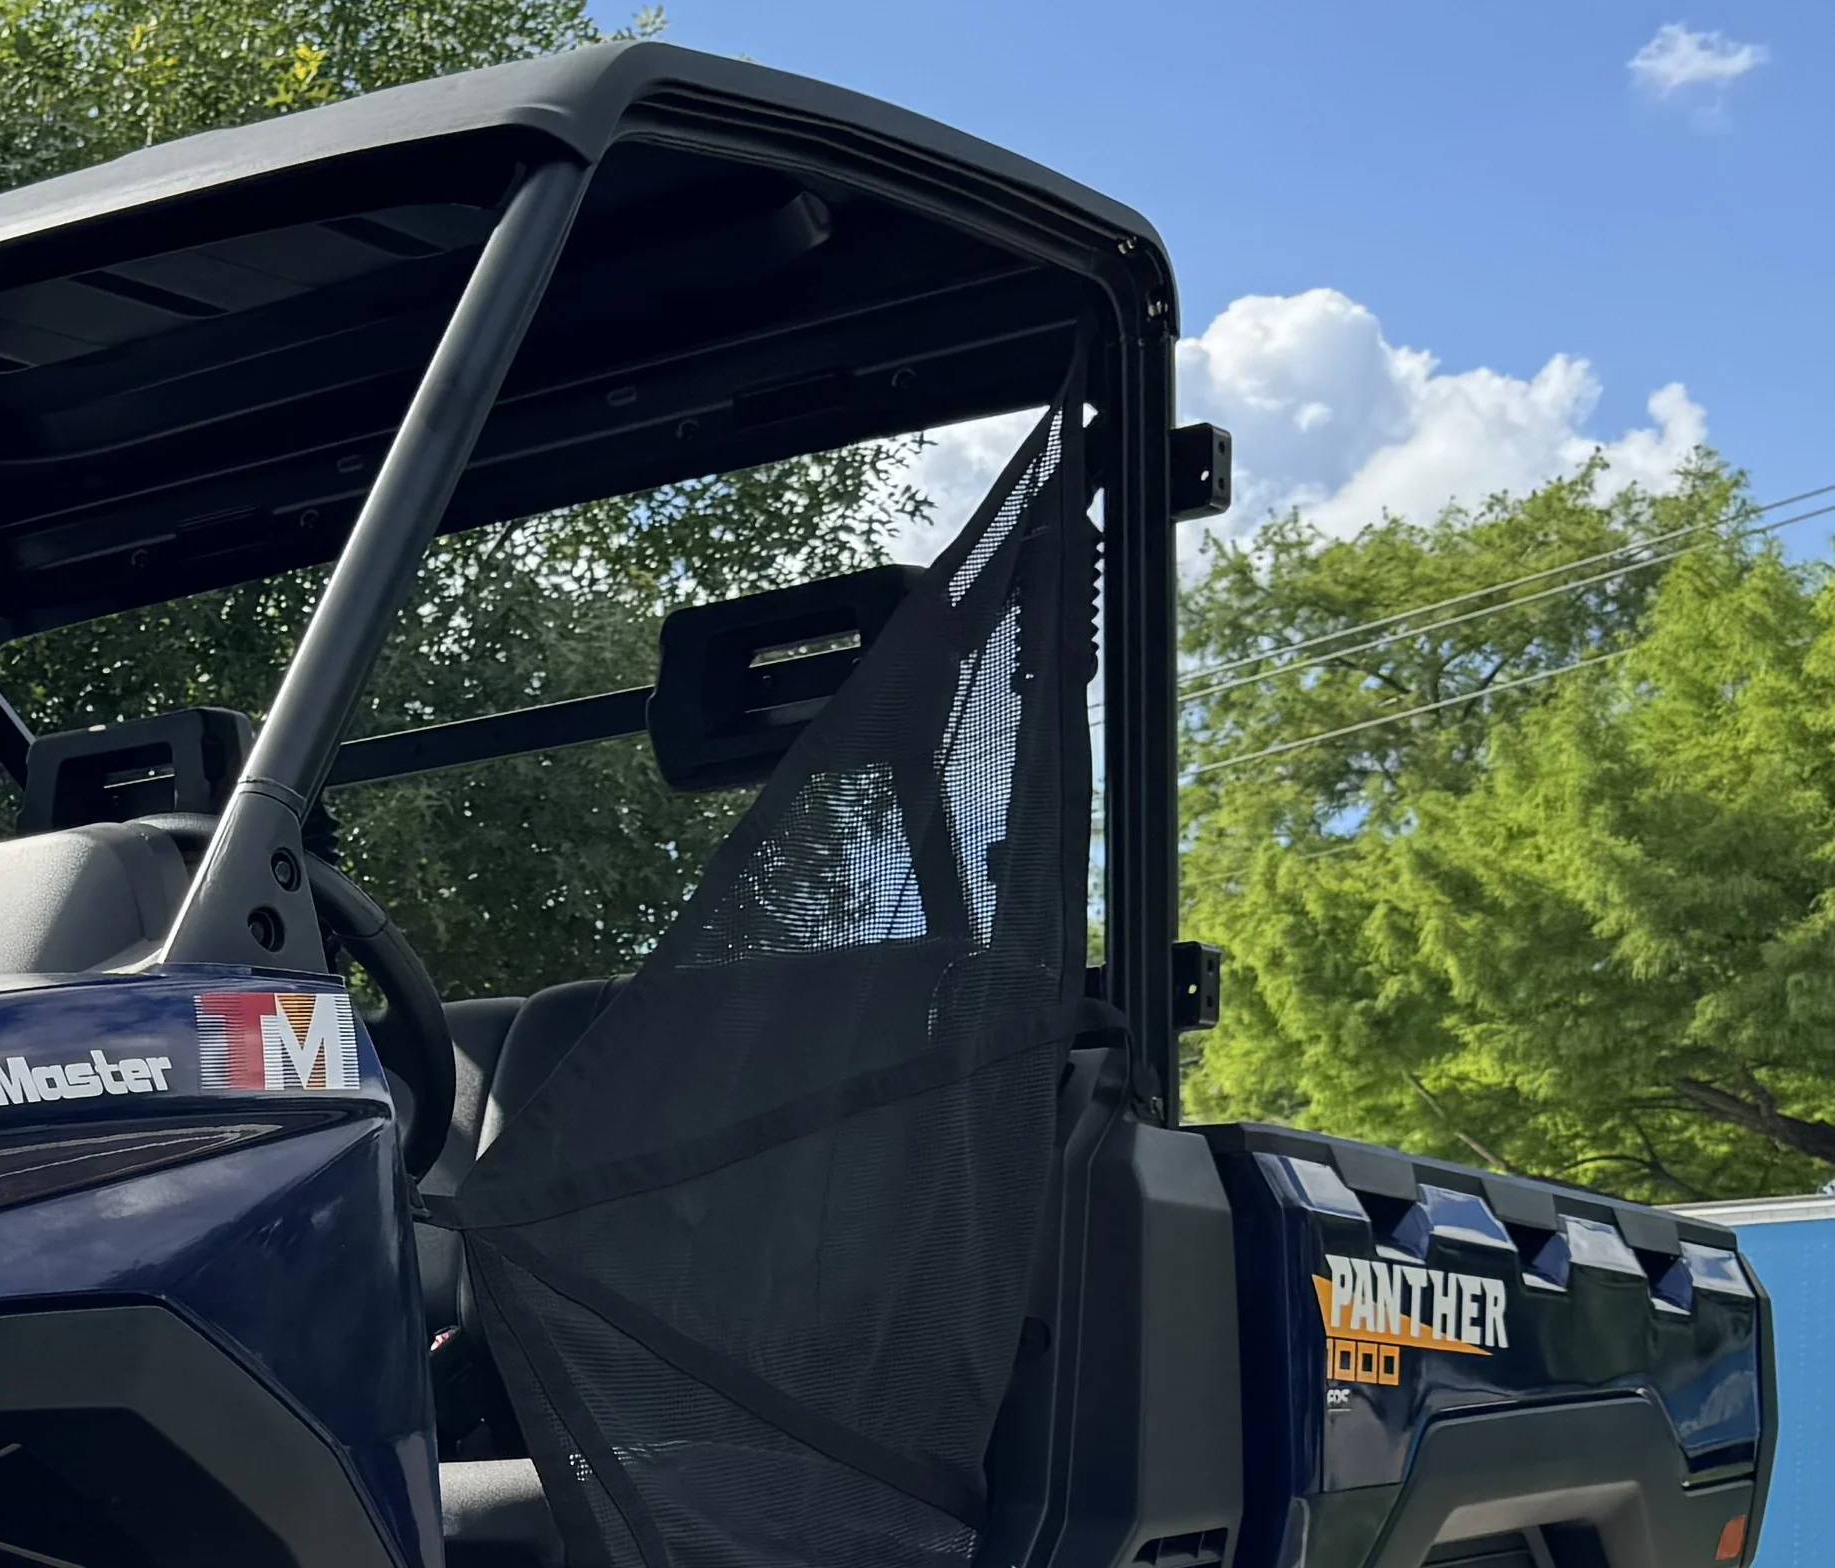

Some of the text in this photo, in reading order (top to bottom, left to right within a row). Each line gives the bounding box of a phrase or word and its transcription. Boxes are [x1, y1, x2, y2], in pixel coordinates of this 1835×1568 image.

[193, 992, 360, 1090] TM
[1325, 1254, 1509, 1348] PANTHER
[1326, 1338, 1401, 1386] 1000
